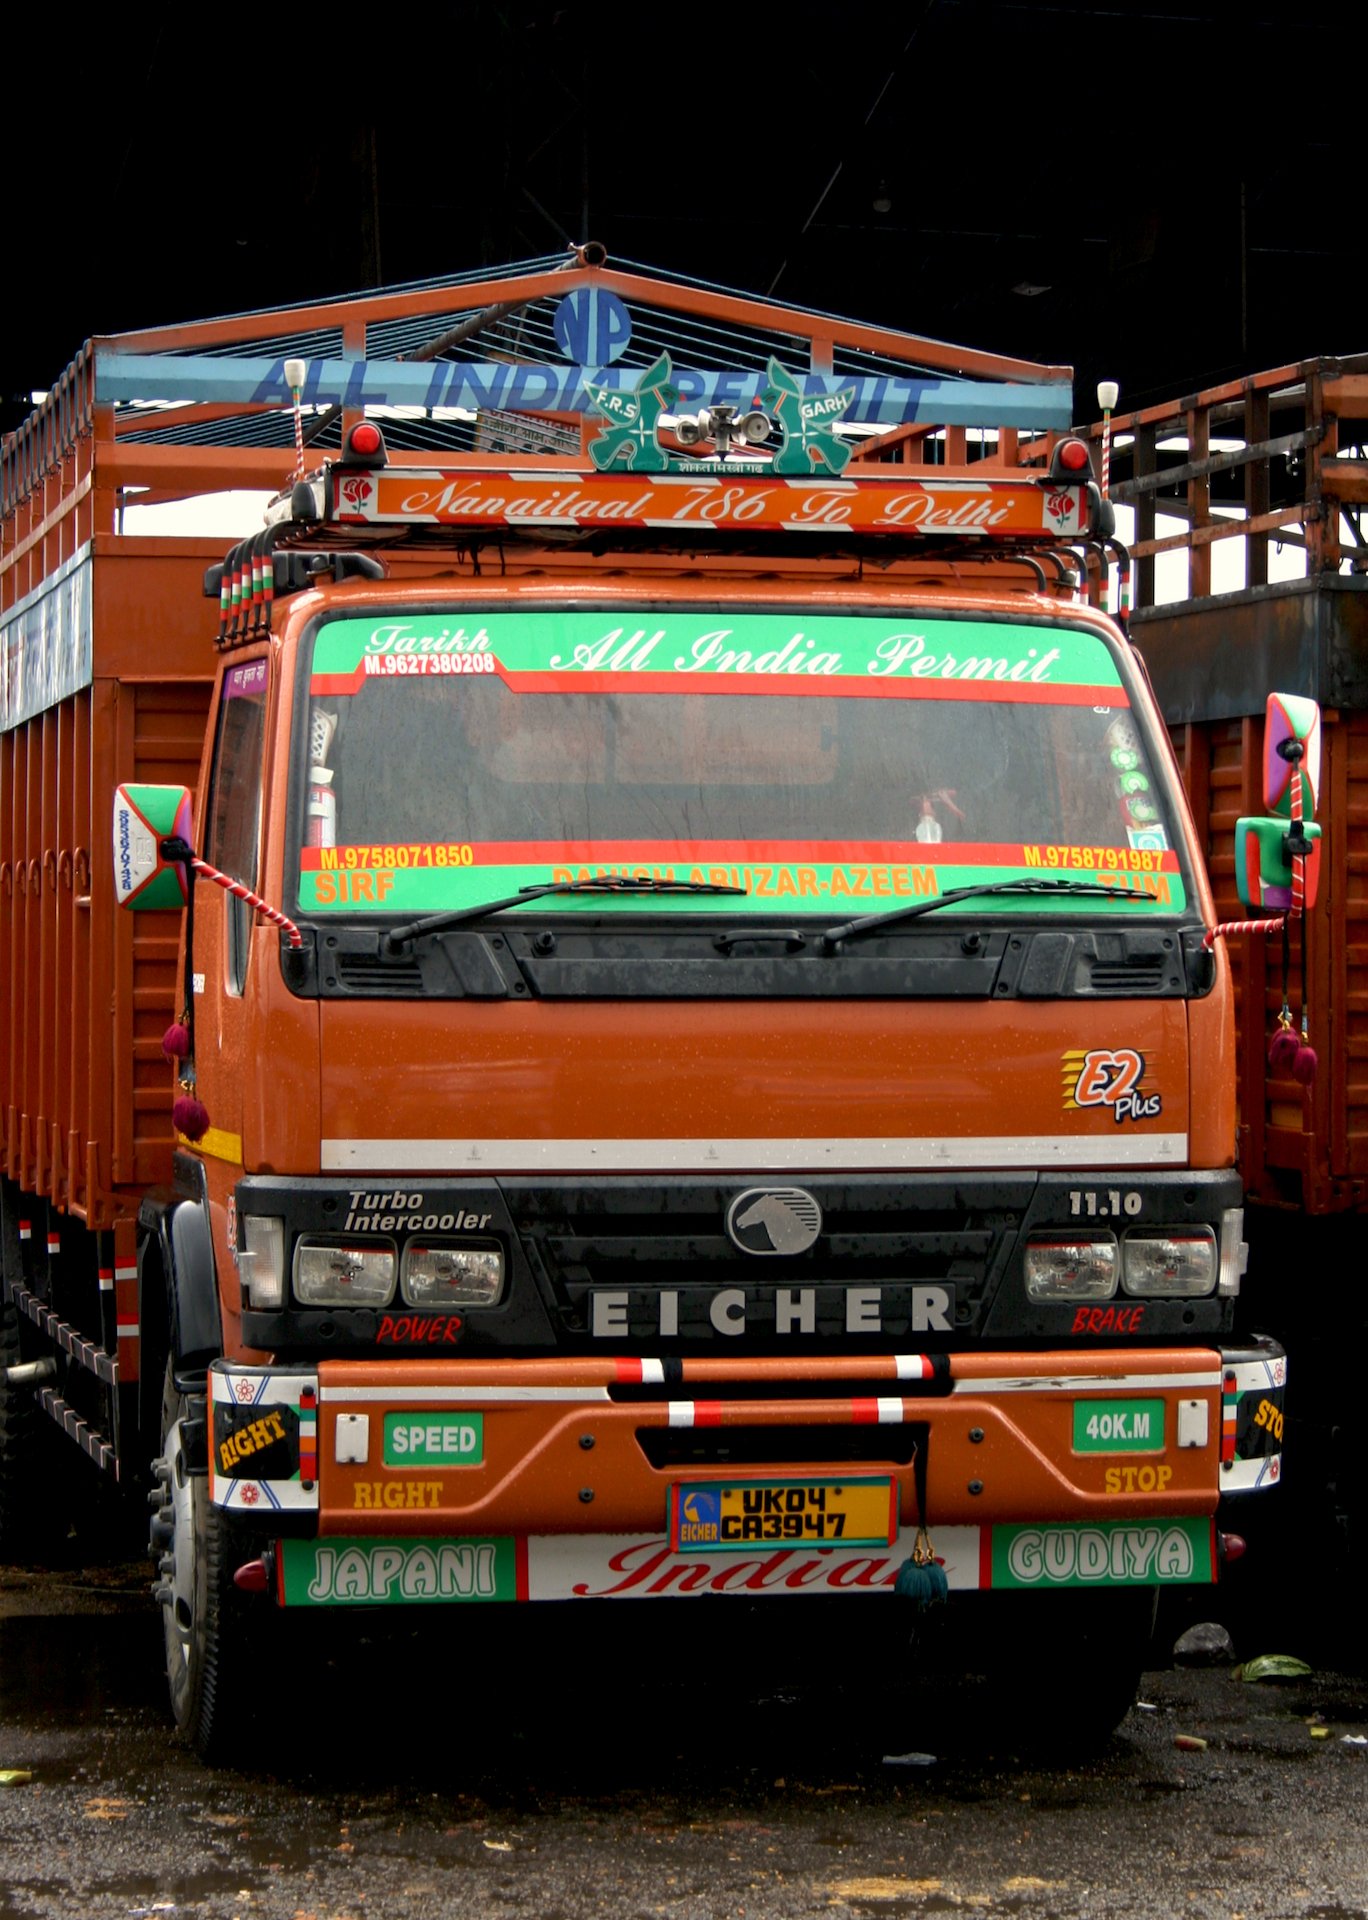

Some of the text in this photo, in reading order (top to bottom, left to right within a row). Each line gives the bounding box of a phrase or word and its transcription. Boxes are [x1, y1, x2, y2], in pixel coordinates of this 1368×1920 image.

[250, 360, 941, 424] ALL INDIA PEMIT
[802, 395, 848, 419] GARH
[672, 487, 778, 521] 786
[790, 490, 860, 523] To
[872, 493, 1015, 526] Delhi
[364, 625, 494, 654] Tarikh
[364, 654, 495, 675] M.9627380208
[549, 627, 1061, 683] All India Permit
[320, 845, 474, 870] M.9758071850
[1023, 846, 1164, 872] M.9758791987
[315, 871, 396, 904] SIRF
[1096, 873, 1172, 905] TUM
[1074, 1049, 1142, 1106] E2
[1115, 1092, 1161, 1121] Plus
[350, 1190, 424, 1210] Turbo
[1069, 1190, 1143, 1217] 11.10
[344, 1210, 493, 1232] Intercooler
[592, 1286, 953, 1338] EICHER
[1071, 1304, 1146, 1336] BRAKE
[375, 1314, 463, 1346] POWER
[1086, 1412, 1150, 1440] 40K.M
[1254, 1399, 1284, 1444] STO
[219, 1409, 287, 1472] RIGHT
[392, 1426, 477, 1454] SPEED
[352, 1480, 444, 1510] RIGHT
[1105, 1465, 1173, 1495] STOP
[743, 1487, 826, 1515] UK04
[680, 1522, 718, 1543] EICHER
[572, 1539, 955, 1596] India
[1008, 1526, 1194, 1584] GUDIYA
[308, 1544, 497, 1601] JAPANI
